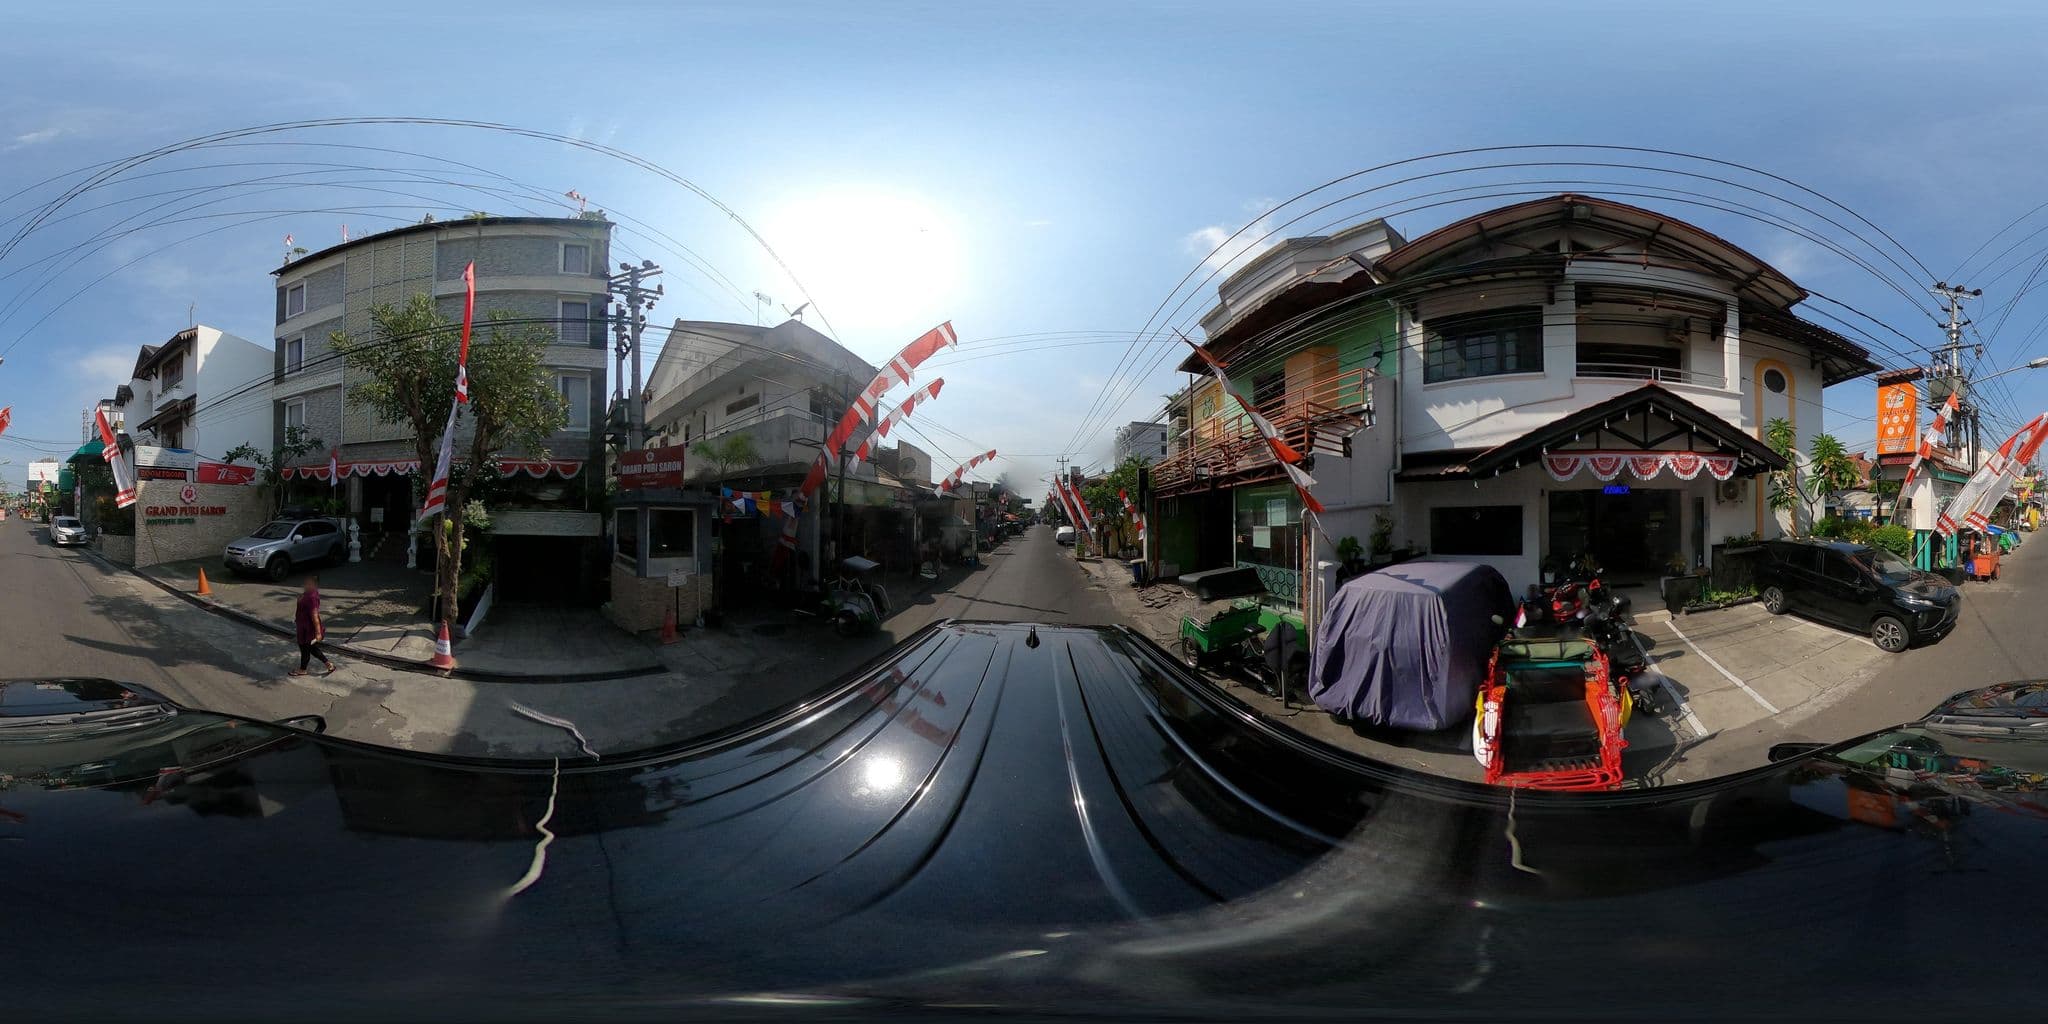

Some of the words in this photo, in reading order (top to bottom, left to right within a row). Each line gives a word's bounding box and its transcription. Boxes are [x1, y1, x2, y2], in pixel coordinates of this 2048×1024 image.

[622, 464, 642, 475] GRAND
[643, 463, 658, 473] PURI
[659, 461, 682, 472] SARON
[145, 506, 178, 516] GRAND
[179, 506, 199, 516] PURI
[200, 506, 226, 516] SARON
